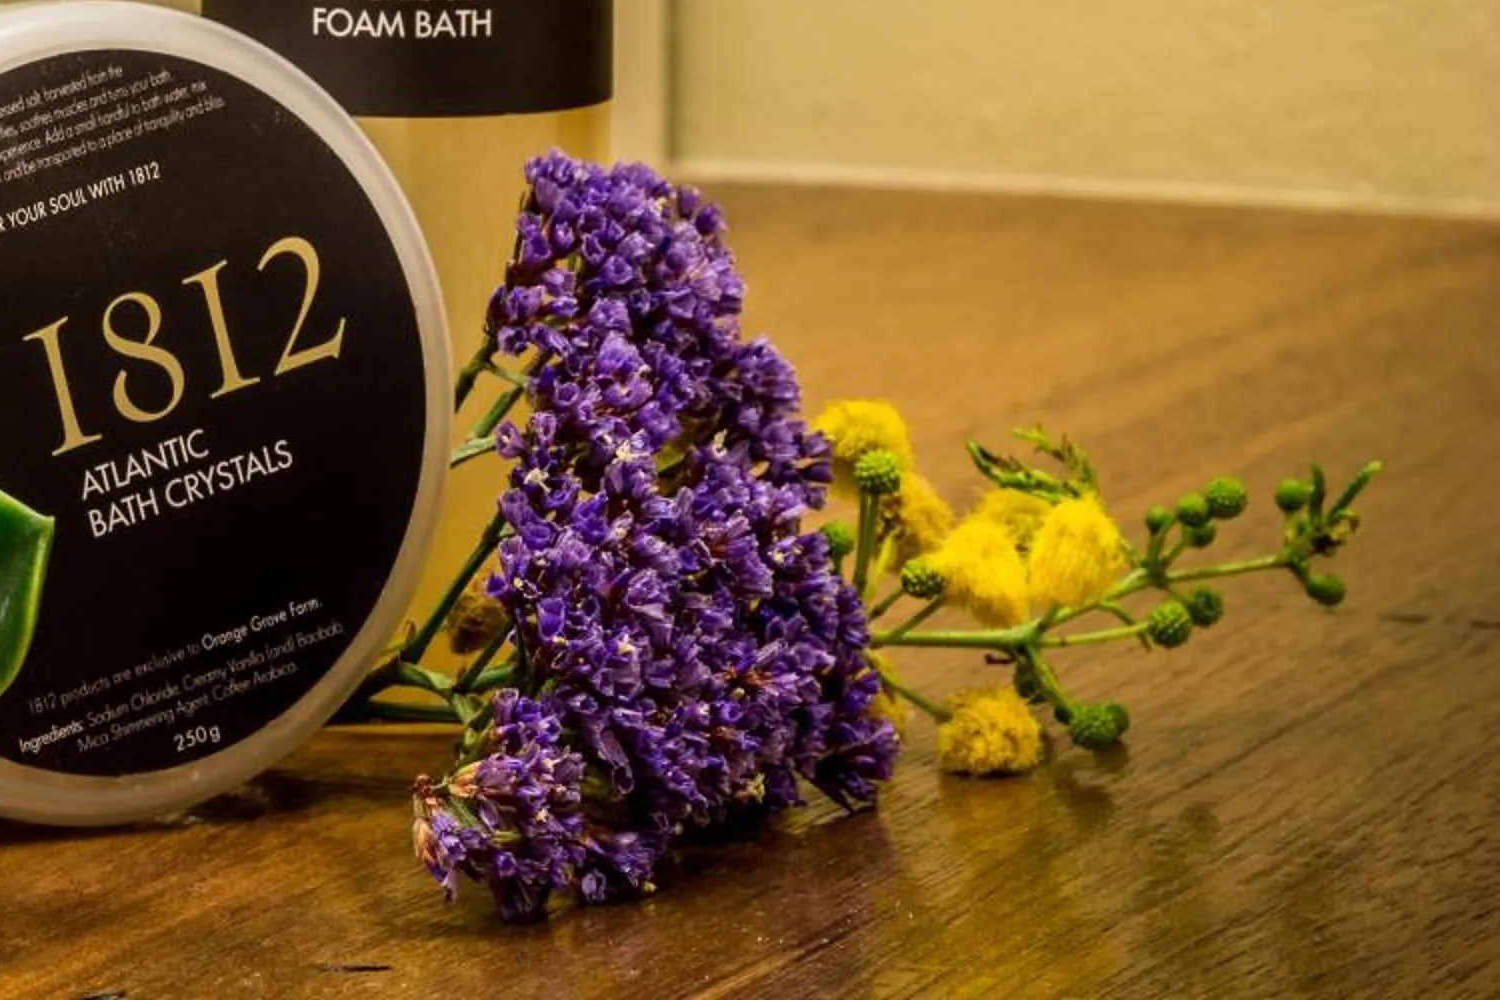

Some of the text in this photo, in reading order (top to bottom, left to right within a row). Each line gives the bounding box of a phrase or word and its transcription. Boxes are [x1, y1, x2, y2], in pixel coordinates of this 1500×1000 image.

[312, 6, 493, 38] FOAM BATH
[45, 127, 65, 143] Add
[74, 114, 98, 134] small
[131, 104, 141, 114] to
[89, 89, 108, 107] and
[130, 80, 149, 96] your
[2, 162, 22, 181] and
[21, 160, 36, 174] be
[86, 141, 97, 151] to
[106, 128, 133, 148] place
[133, 121, 143, 136] of
[185, 100, 204, 118] and
[5, 202, 48, 227] YOUR
[49, 189, 88, 214] SOUL
[87, 174, 126, 198] WITH
[128, 162, 161, 184] 1812
[22, 236, 346, 456] 1812
[81, 428, 209, 500] ATLANTIC
[88, 439, 294, 538] BATH CRYSTALS
[29, 599, 323, 713] 1812 products are exclusive to Orange Grove Farm.
[76, 734, 109, 752] Mica
[86, 704, 130, 727] Sodium
